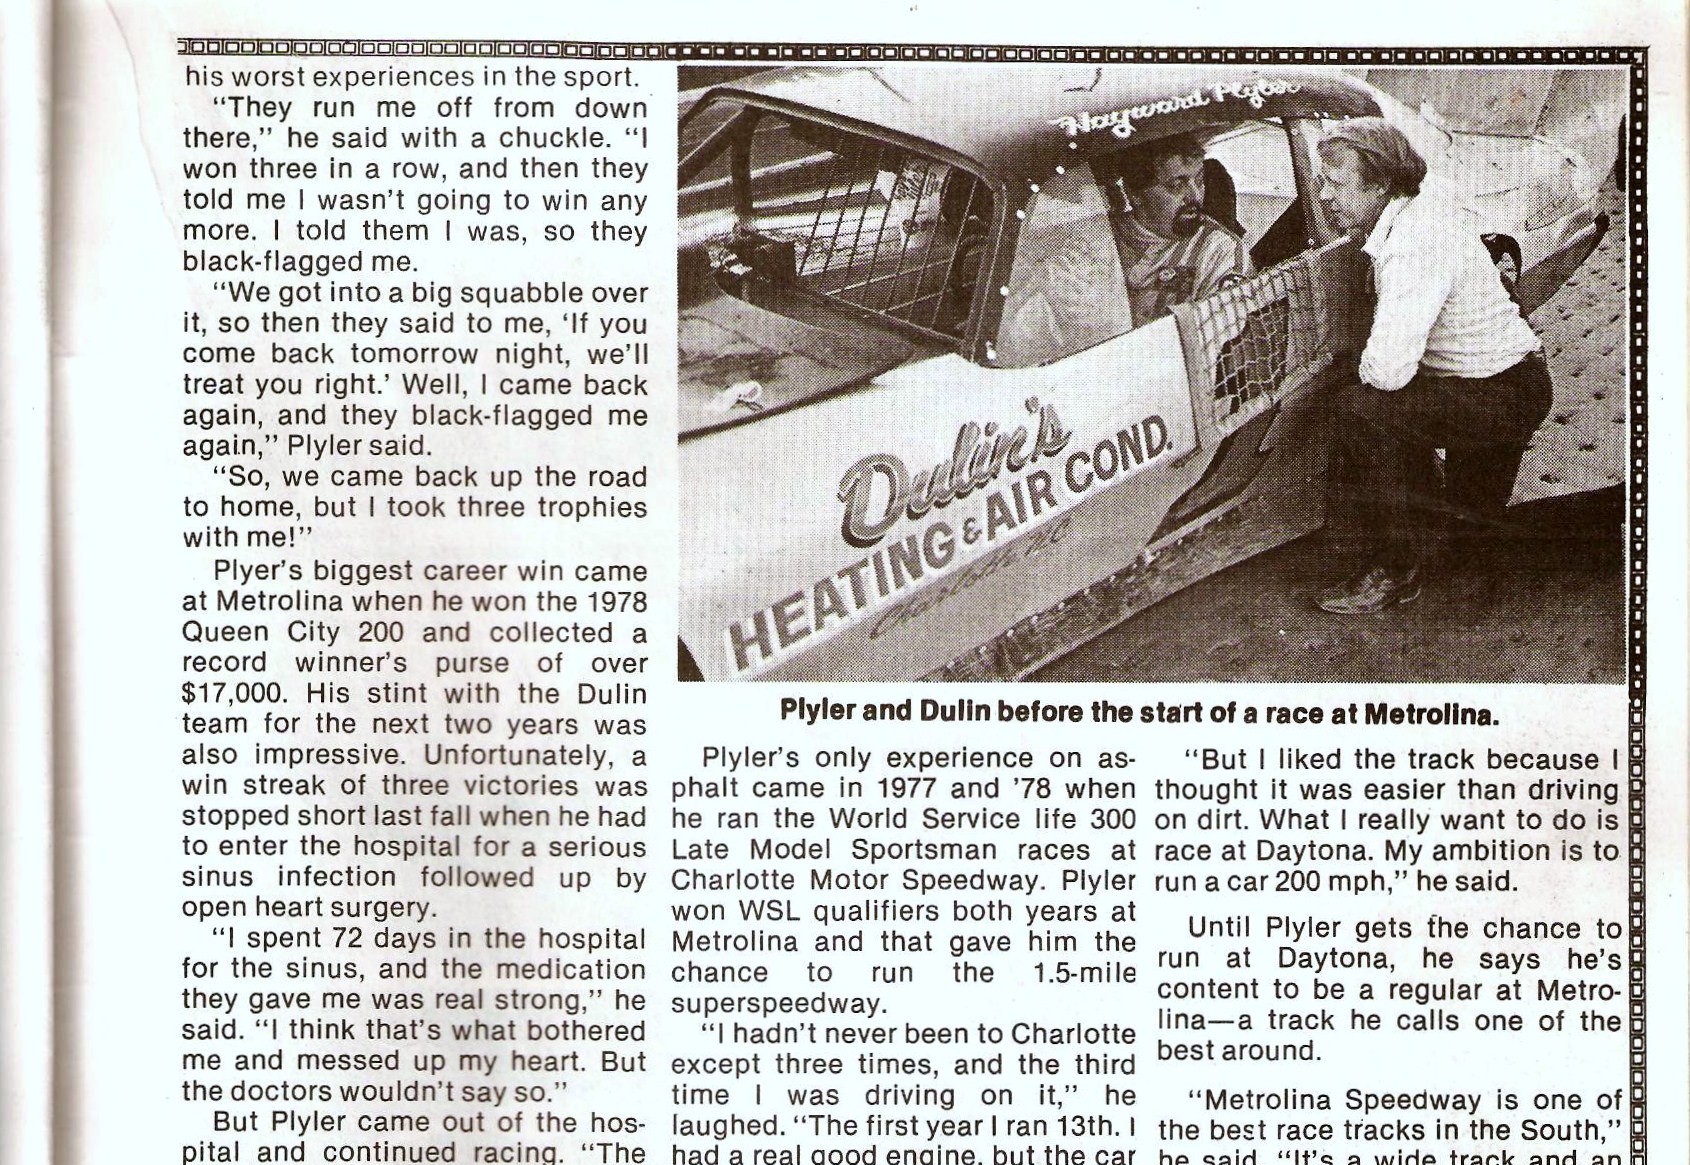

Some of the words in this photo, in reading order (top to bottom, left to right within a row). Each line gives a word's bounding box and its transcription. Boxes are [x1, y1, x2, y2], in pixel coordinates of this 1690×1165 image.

[186, 65, 224, 87] his
[231, 66, 305, 87] worst
[313, 65, 475, 92] experiences
[484, 70, 506, 86] in
[514, 65, 556, 87] the
[564, 66, 639, 91] sport.
[183, 249, 363, 277] black-flagged
[372, 254, 418, 272] me.
[183, 403, 263, 431] again,
[278, 403, 326, 426] and
[341, 403, 398, 431] they
[412, 403, 592, 431] black-flagged
[608, 408, 648, 427] me
[837, 395, 1072, 548] Dulin's
[183, 496, 209, 517] to
[221, 495, 301, 522] home,
[314, 495, 356, 518] but
[369, 496, 374, 517] I
[387, 496, 446, 518] took
[457, 495, 525, 518] three
[538, 495, 648, 523] trophies
[729, 522, 956, 673] HEATING
[962, 516, 984, 546] &
[987, 469, 1058, 542] AIR
[1065, 414, 1174, 493] COND.
[182, 619, 269, 643] Queen
[287, 619, 341, 647] City
[358, 620, 404, 643] 200
[422, 621, 470, 643] and
[490, 621, 613, 643] collected
[632, 627, 648, 644] a
[181, 680, 288, 707] $17,000.
[307, 681, 350, 704] His
[367, 681, 427, 704] stint
[444, 682, 500, 704] with
[518, 682, 560, 704] the
[578, 682, 647, 705] Dulin
[780, 696, 857, 726] Plyler
[862, 698, 912, 722] and
[920, 698, 991, 722] Dulin
[998, 699, 1084, 723] before
[1090, 700, 1134, 723] the
[1140, 701, 1204, 724] start
[1209, 700, 1237, 724] of
[1243, 706, 1258, 724] a
[1266, 706, 1324, 725] race
[1331, 703, 1358, 725] at
[1365, 702, 1500, 727] Metrolina.
[182, 742, 238, 765] also
[255, 742, 406, 770] impressive.
[425, 743, 613, 771] Unfortunately,
[632, 749, 647, 767] a
[181, 773, 227, 795] win
[243, 774, 326, 796] streak
[340, 773, 367, 796] of
[381, 773, 449, 796] three
[464, 774, 578, 797] victories
[595, 780, 648, 797] was
[672, 838, 729, 861] Late
[750, 838, 830, 860] Model
[852, 838, 997, 865] Sportsman
[1018, 843, 1090, 861] races
[1111, 839, 1136, 861] at
[1155, 844, 1212, 862] race
[1221, 840, 1247, 862] at
[1257, 839, 1374, 866] Daytona.
[1385, 839, 1423, 866] My
[1432, 838, 1550, 862] ambition
[1561, 839, 1583, 862] is
[1593, 840, 1620, 862] to
[182, 865, 253, 887] sinus
[279, 864, 396, 887] infection
[420, 865, 534, 888] followed
[560, 871, 591, 893] up
[617, 867, 647, 894] by
[671, 868, 795, 891] Charlotte
[811, 868, 889, 890] Motor
[902, 868, 1046, 896] Speedway.
[1062, 869, 1136, 896] Plyler
[182, 900, 247, 923] open
[256, 895, 323, 918] heart
[331, 900, 437, 923] surgery.
[1189, 915, 1250, 938] Until
[1266, 915, 1342, 943] Plyler
[1355, 917, 1412, 944] gets
[1427, 914, 1469, 939] the
[1483, 916, 1581, 940] chance
[1596, 918, 1623, 940] to
[672, 929, 798, 952] Metrolina
[814, 930, 863, 952] and
[880, 930, 933, 952] that
[949, 935, 1011, 958] gave
[1029, 929, 1077, 952] him
[1094, 930, 1136, 953] the
[671, 991, 887, 1019] superspeedway.
[1157, 978, 1259, 1000] content
[1273, 978, 1299, 1000] to
[1313, 977, 1345, 1000] be
[1359, 983, 1374, 1001] a
[1389, 977, 1483, 1006] regular
[1496, 979, 1522, 1001] at
[1537, 979, 1622, 1001] Metro-
[182, 1053, 221, 1071] me
[234, 1048, 283, 1071] and
[297, 1049, 399, 1071] messed
[414, 1054, 446, 1076] up
[459, 1054, 497, 1077] my
[512, 1050, 586, 1072] heart.
[601, 1050, 647, 1073] But
[1157, 1039, 1215, 1061] best
[1222, 1039, 1321, 1061] around.
[671, 1053, 761, 1080] except
[775, 1052, 843, 1075] three
[858, 1052, 939, 1080] times,
[954, 1052, 1003, 1076] and
[1018, 1052, 1060, 1075] the
[1075, 1053, 1135, 1076] third
